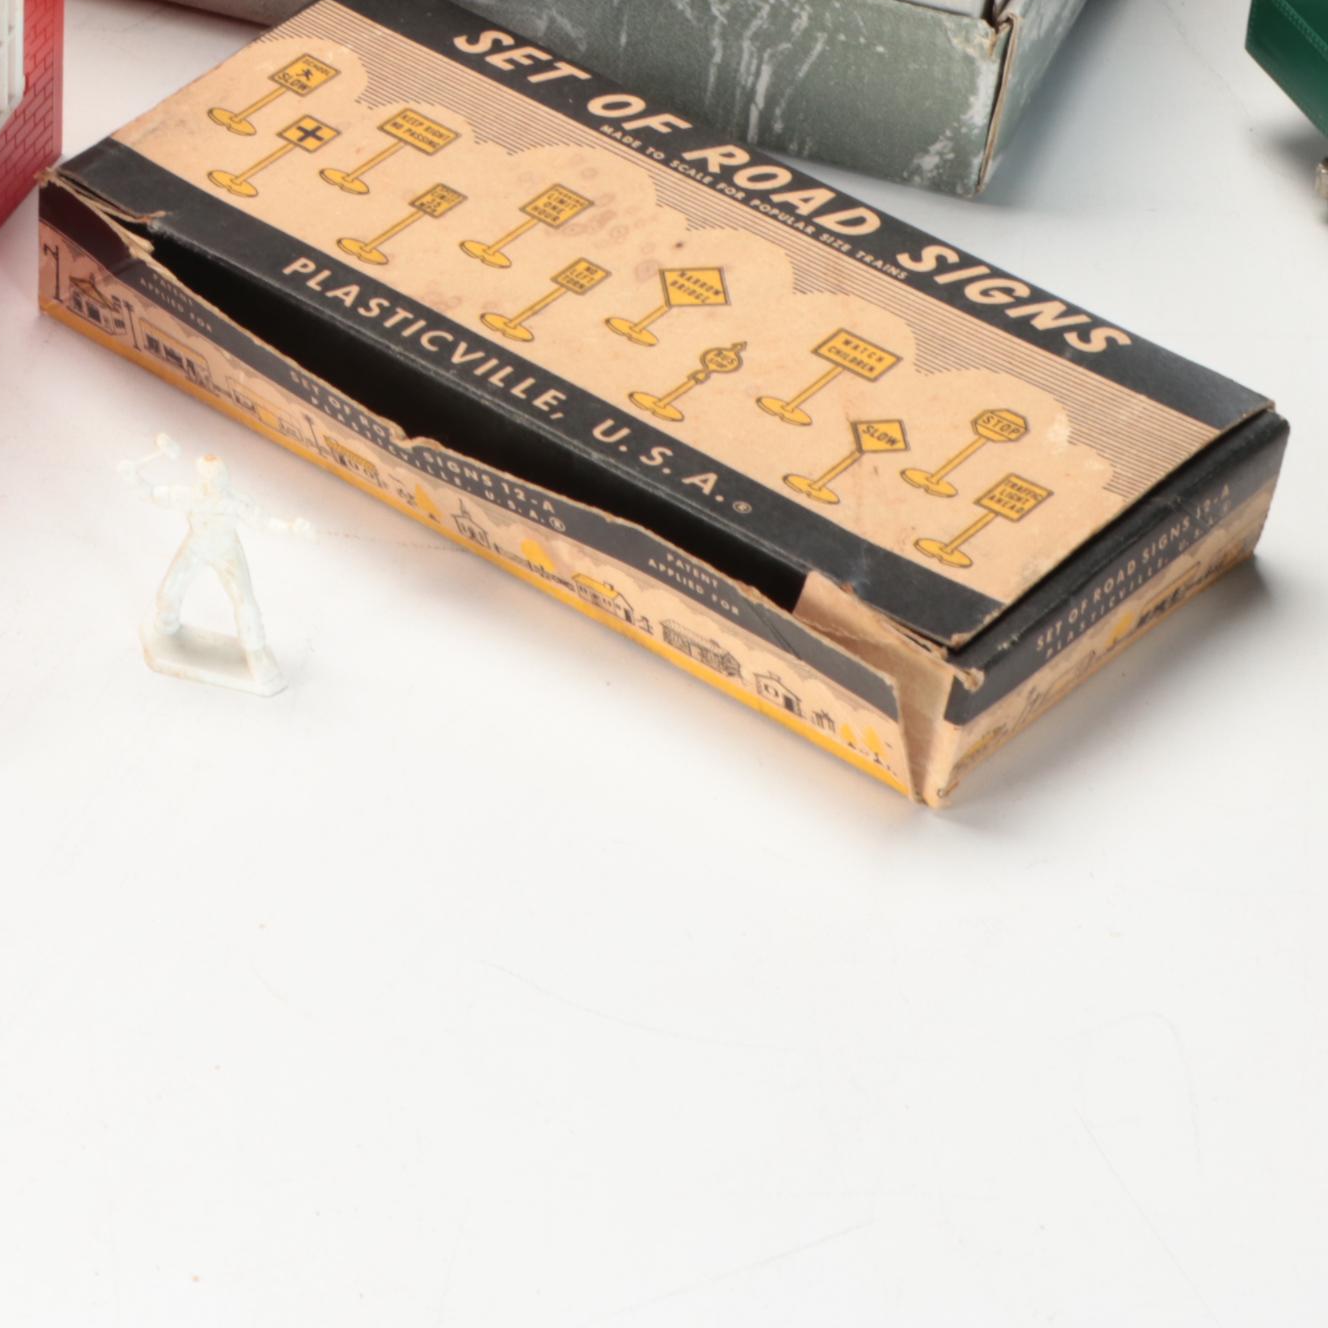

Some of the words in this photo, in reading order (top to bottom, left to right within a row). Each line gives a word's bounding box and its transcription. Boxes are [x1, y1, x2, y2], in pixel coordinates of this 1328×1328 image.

[454, 30, 592, 83] SET
[586, 93, 694, 133] OF
[681, 144, 881, 235] ROAD
[896, 245, 1132, 353] SIGNS
[599, 124, 643, 149] MADE
[645, 146, 666, 160] TO
[670, 160, 714, 185] SCALE
[716, 182, 746, 201] FOR
[750, 198, 816, 236] POPULAR
[819, 232, 851, 253] SIZE
[855, 250, 908, 280] TRAINS
[283, 257, 566, 420] PLASTICVILLE,
[826, 346, 877, 373] CHILDREN
[840, 339, 885, 363] WATCH
[328, 395, 351, 415] OF
[359, 414, 386, 437] RO
[422, 452, 492, 488] SIGNS
[501, 481, 555, 514] 12-A
[862, 424, 900, 446] SLOW
[982, 415, 1021, 435] STOP
[648, 558, 705, 595] APPLIED
[712, 593, 740, 617] FOR
[666, 553, 718, 588] PATENT
[1035, 621, 1063, 652] SET
[1068, 599, 1088, 622] OF
[1093, 559, 1136, 602] ROAD
[1141, 516, 1191, 564] SIGNS
